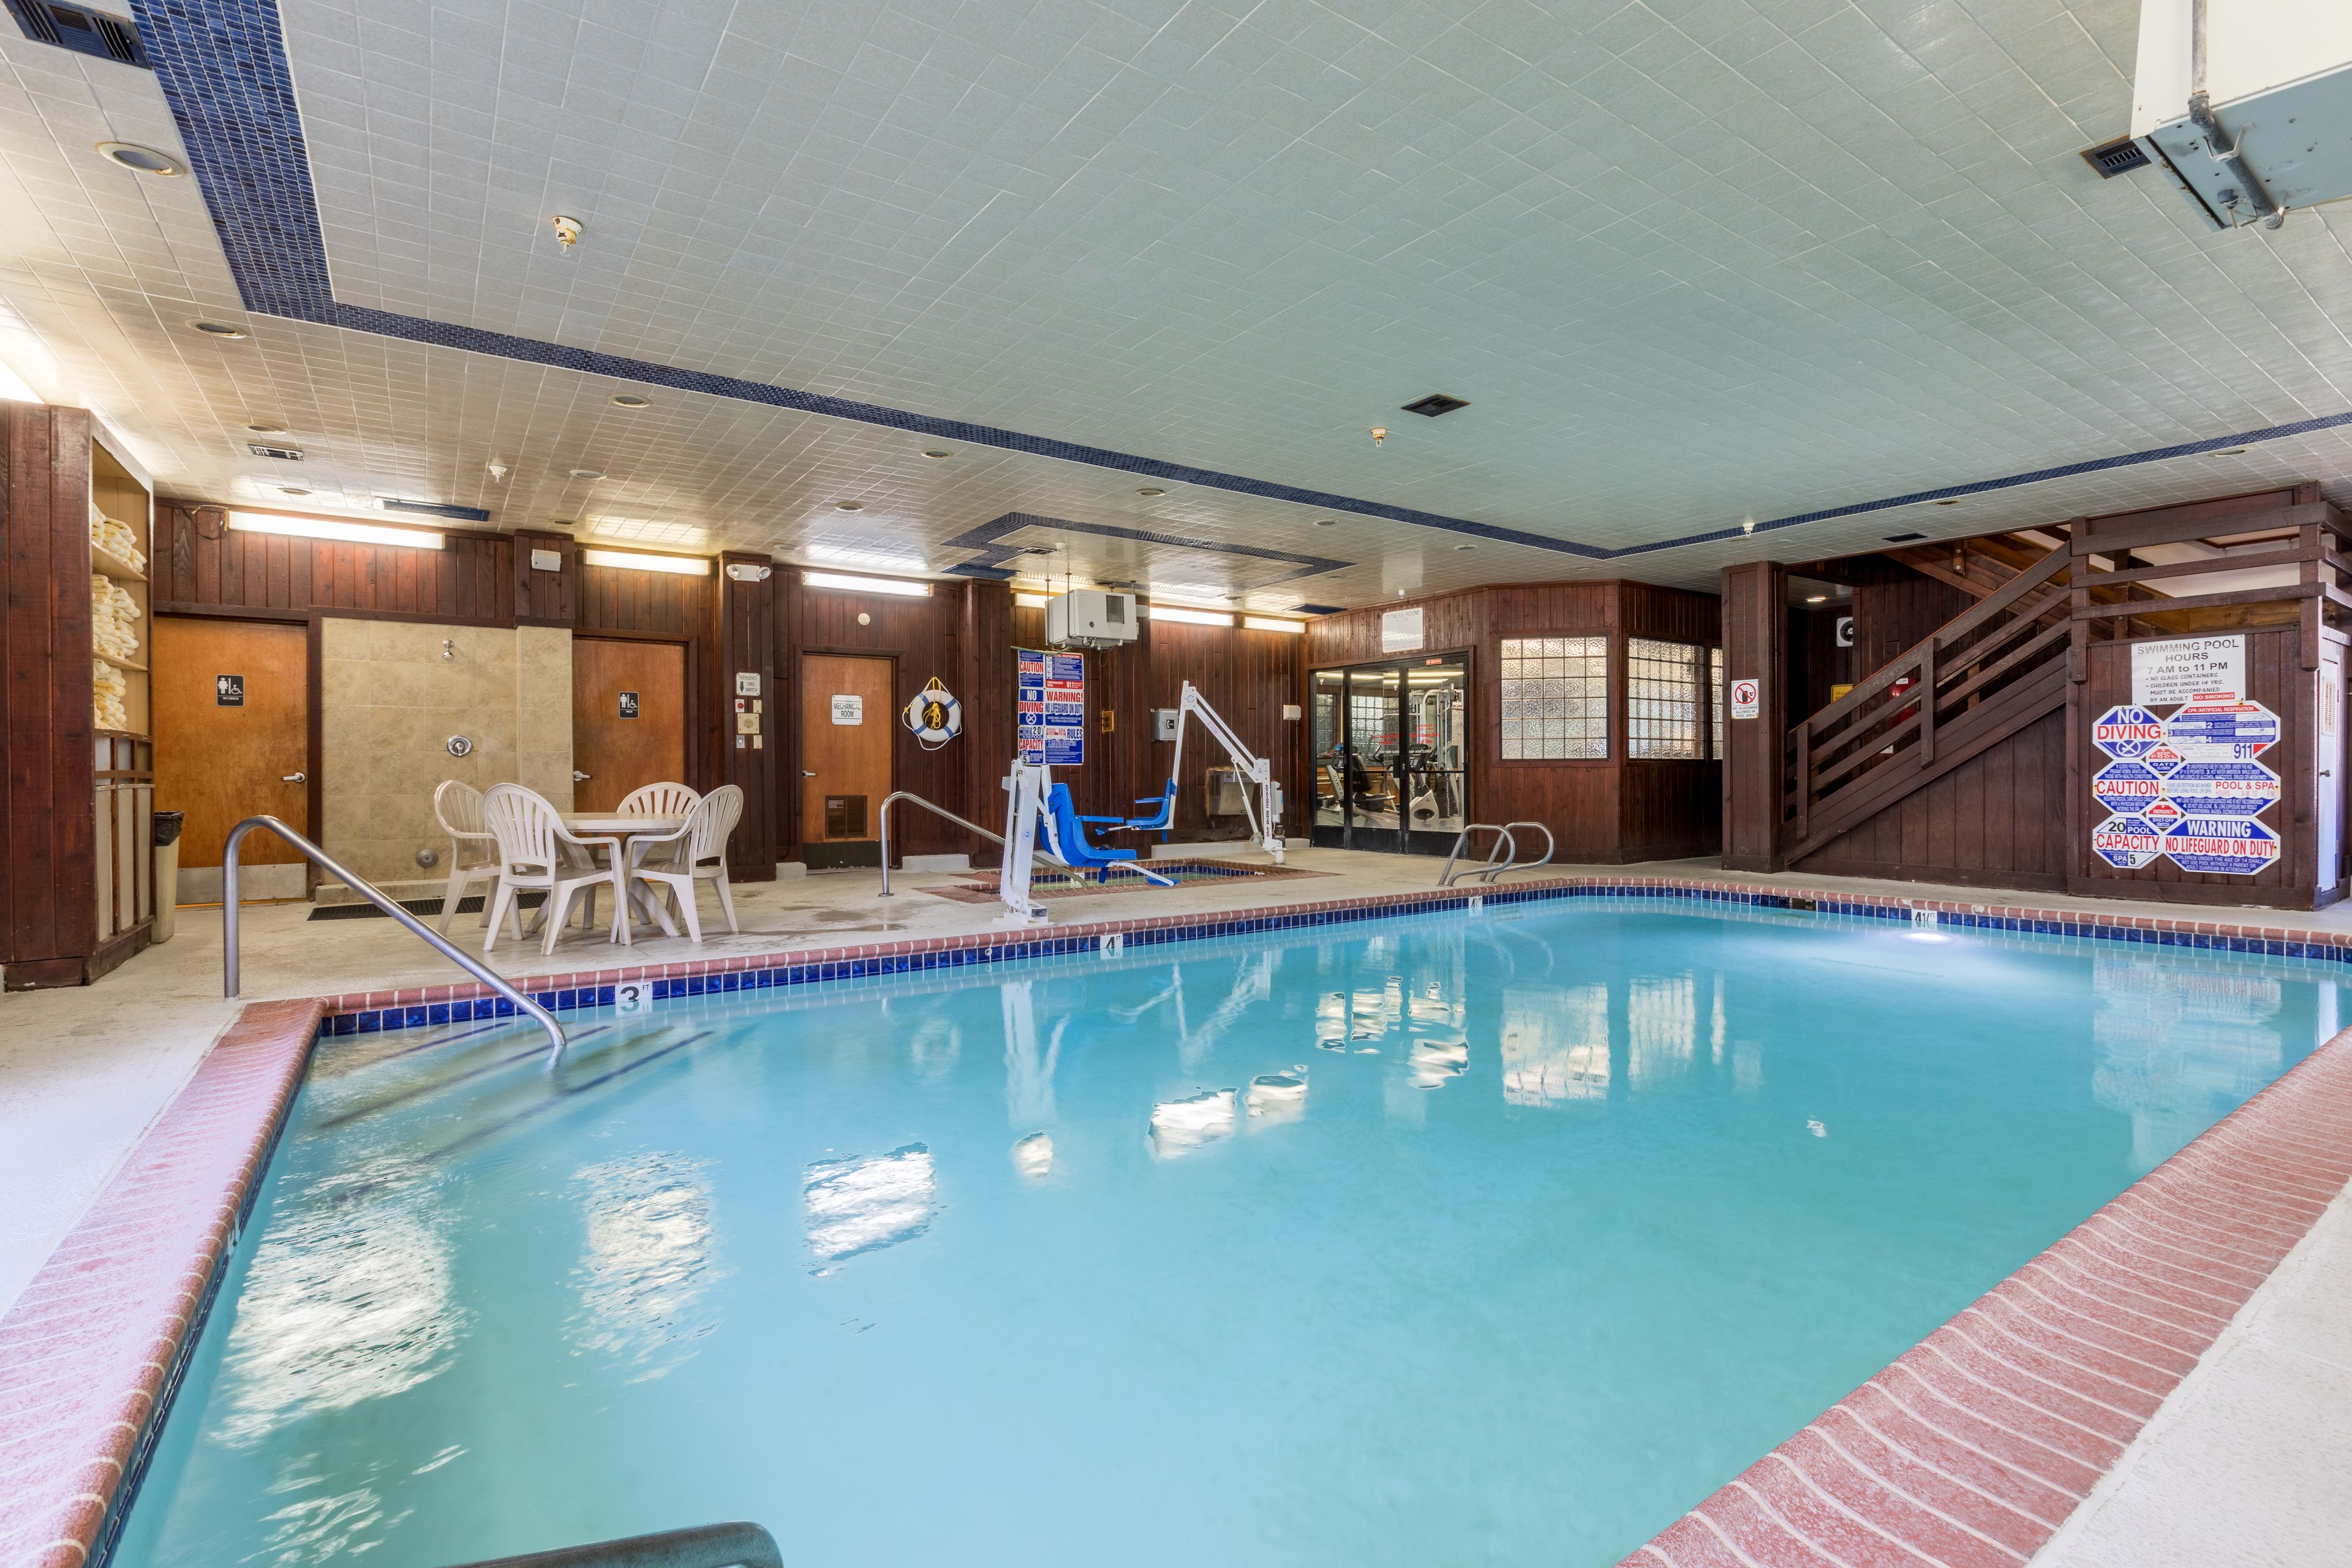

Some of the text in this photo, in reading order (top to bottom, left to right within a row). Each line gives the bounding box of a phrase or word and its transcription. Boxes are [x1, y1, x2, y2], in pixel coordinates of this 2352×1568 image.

[2138, 639, 2239, 655] SWIMMING POOL
[2166, 652, 2209, 662] HOURS
[1019, 662, 1043, 673] CAUTION
[1027, 690, 1037, 701] NO
[1047, 691, 1083, 703] WARNING!
[1019, 702, 1043, 712] DIVING
[1046, 703, 1083, 714] NO LIFEGUARD ON DUTY
[2117, 709, 2144, 724] NO
[1068, 729, 1083, 739] RULES
[2097, 724, 2161, 740] DIVING
[1019, 739, 1043, 750] CAPACITY
[2234, 744, 2252, 759] 911
[2097, 780, 2159, 794] CAUTION
[2108, 821, 2126, 832] 20
[2187, 820, 2252, 838] WARNING
[2097, 834, 2160, 850] CAPACITY
[2165, 837, 2274, 856] NO LIFEGUARD ON DUTY
[2130, 854, 2136, 864] 5
[1106, 937, 1115, 949] 4
[620, 986, 639, 1002] 3
